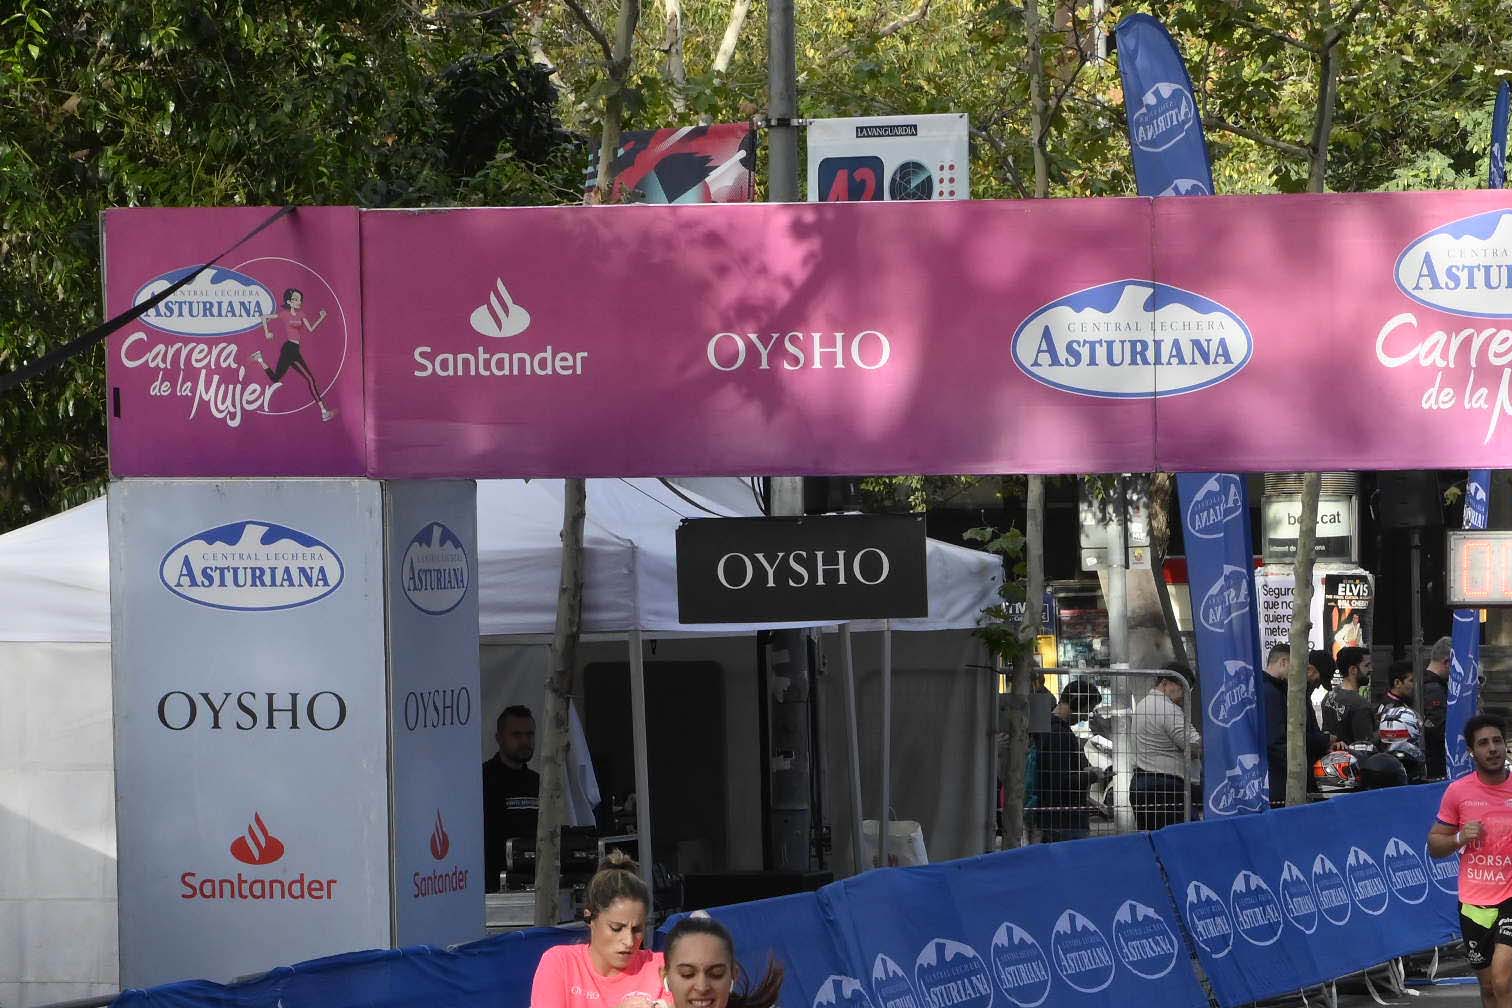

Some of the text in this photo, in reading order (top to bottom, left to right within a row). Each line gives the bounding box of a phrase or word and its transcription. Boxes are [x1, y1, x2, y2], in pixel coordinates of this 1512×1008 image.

[174, 288, 261, 299] ENTRAL LECHERA
[1067, 319, 1226, 334] CENTRAL LECHERA
[120, 331, 239, 369] Carrera
[413, 346, 588, 372] Santander
[706, 330, 891, 370] OYSHO
[1030, 324, 1234, 367] ASTURIANA
[150, 368, 283, 428] de la Mujer
[1422, 371, 1456, 410] de
[1463, 371, 1489, 409] la
[174, 553, 331, 588] ASTURIANA
[202, 552, 324, 565] CENTRAL LECHERA
[407, 558, 466, 592] ASTURIANA
[717, 547, 890, 590] OYSHO
[1264, 601, 1280, 612] que
[1337, 583, 1368, 597] ELVIS
[157, 691, 347, 732] OYSHO
[404, 686, 471, 732] OYSHO
[180, 871, 338, 900] Santander
[413, 864, 469, 899] Santander
[1467, 867, 1505, 881] SUMA
